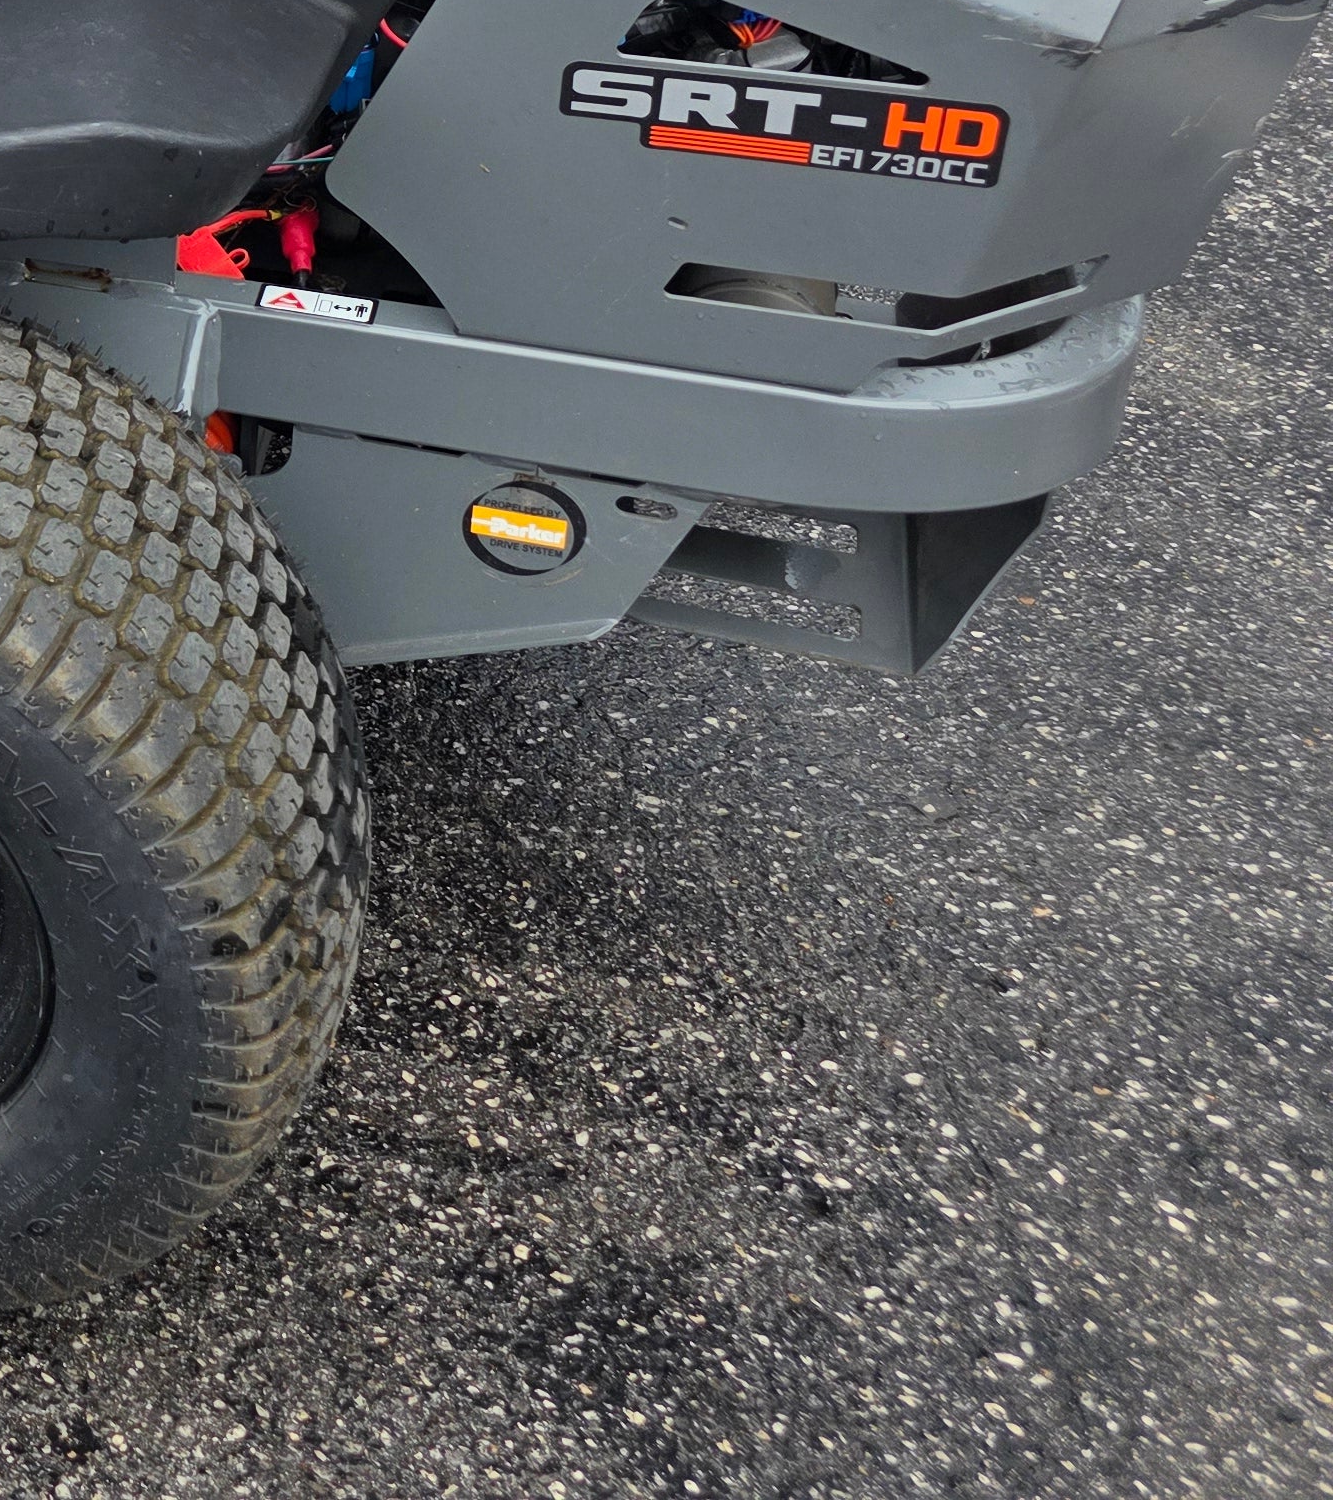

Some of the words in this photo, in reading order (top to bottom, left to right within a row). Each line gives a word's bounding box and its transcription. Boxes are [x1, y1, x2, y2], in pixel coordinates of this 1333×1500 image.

[810, 144, 864, 170] EFI
[871, 151, 989, 185] 730CC
[484, 498, 544, 516] PROPELLED
[546, 508, 561, 519] BY
[490, 516, 563, 544] Parker
[490, 538, 520, 551] DRIVE
[521, 543, 564, 558] SYSTEM
